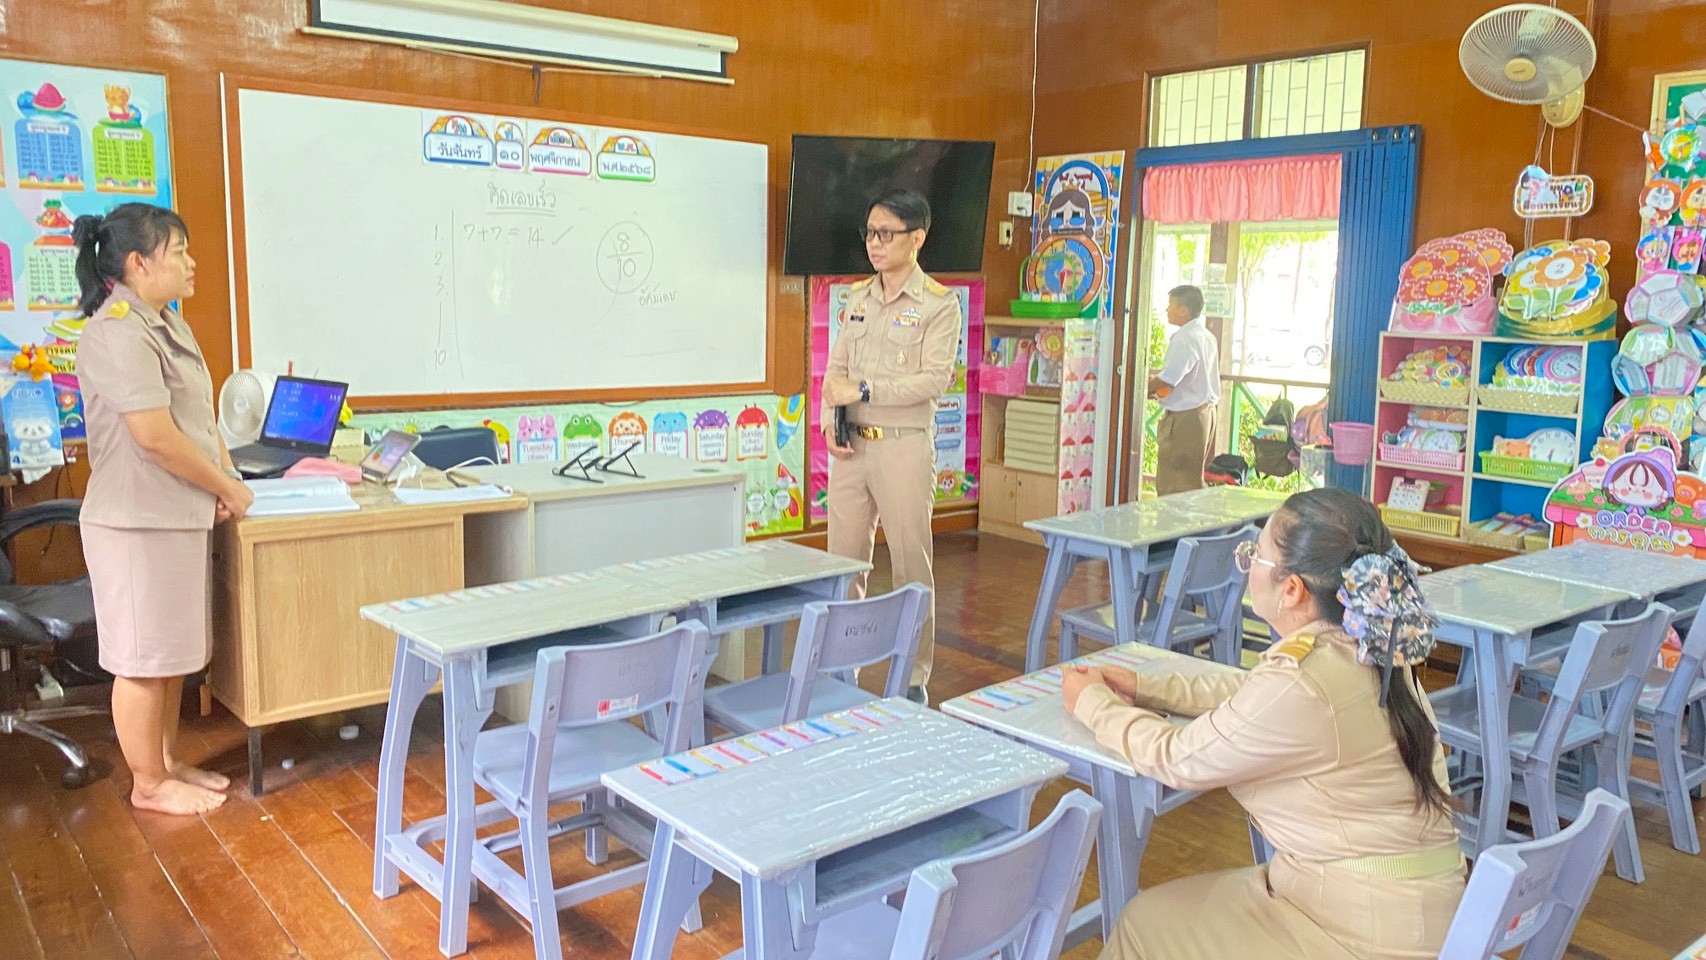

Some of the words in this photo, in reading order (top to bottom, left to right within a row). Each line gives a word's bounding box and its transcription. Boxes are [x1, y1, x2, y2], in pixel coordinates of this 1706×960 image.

[438, 141, 482, 159] วันจันทร์
[500, 150, 520, 161] ๑๐
[530, 151, 581, 167] พฤศจิกายน
[603, 161, 651, 176] พ.ศ.๒๕๖๘
[528, 226, 545, 247] 14
[617, 231, 629, 252] 8
[617, 256, 636, 281] 10
[523, 443, 554, 454] Tuesday
[1597, 510, 1671, 538] ORDER
